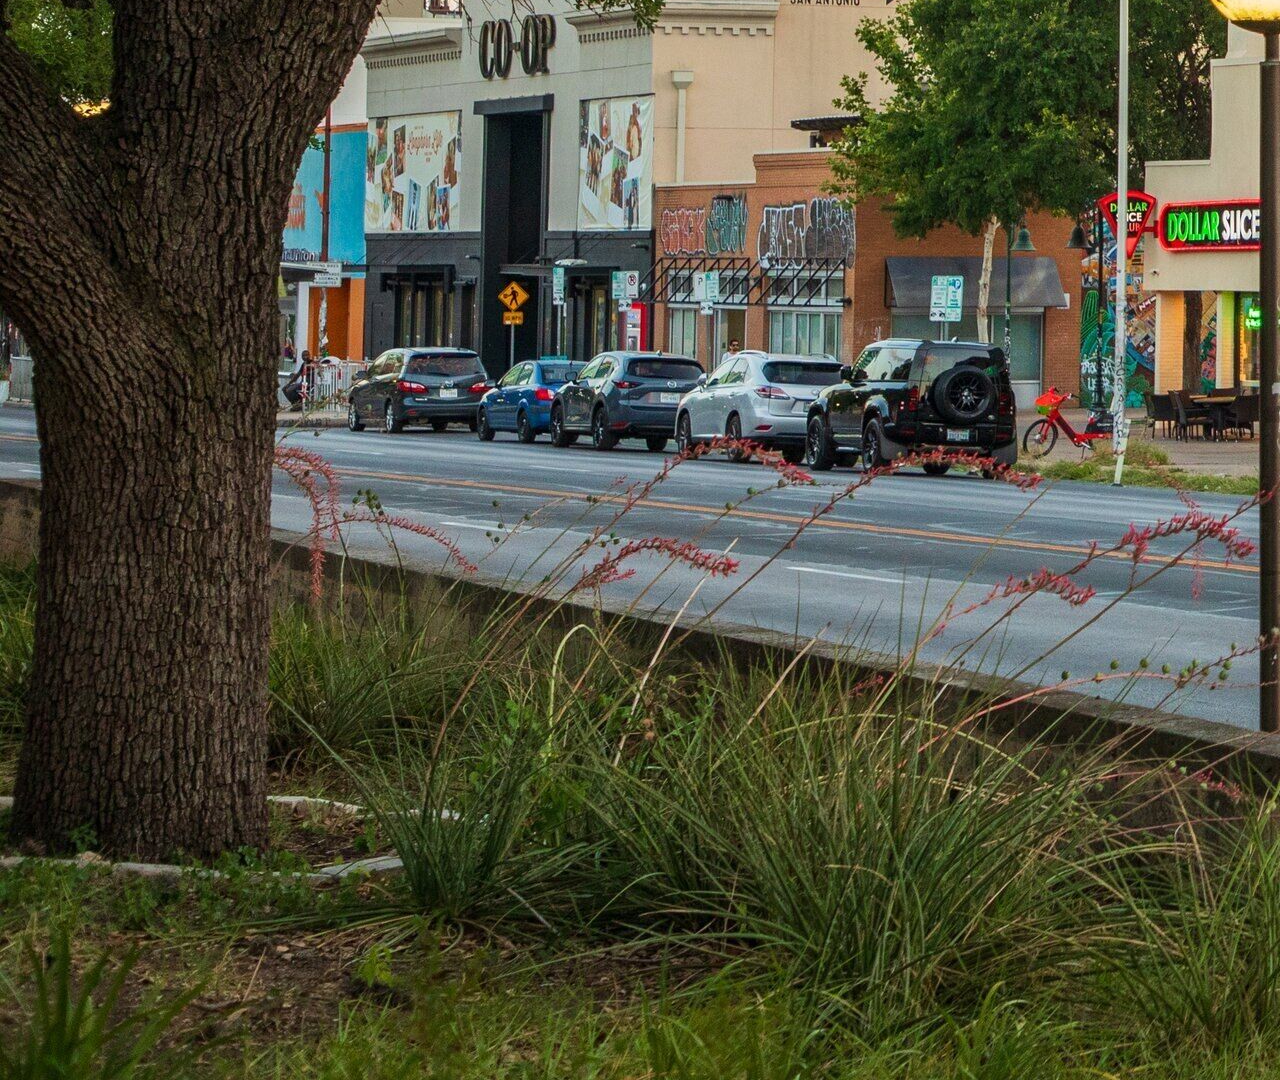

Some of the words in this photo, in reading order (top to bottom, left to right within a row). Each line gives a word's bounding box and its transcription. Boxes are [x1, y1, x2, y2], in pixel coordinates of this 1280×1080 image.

[479, 14, 556, 80] CO-OP
[1110, 202, 1148, 213] DLAR
[1168, 210, 1220, 242] DOLLAR
